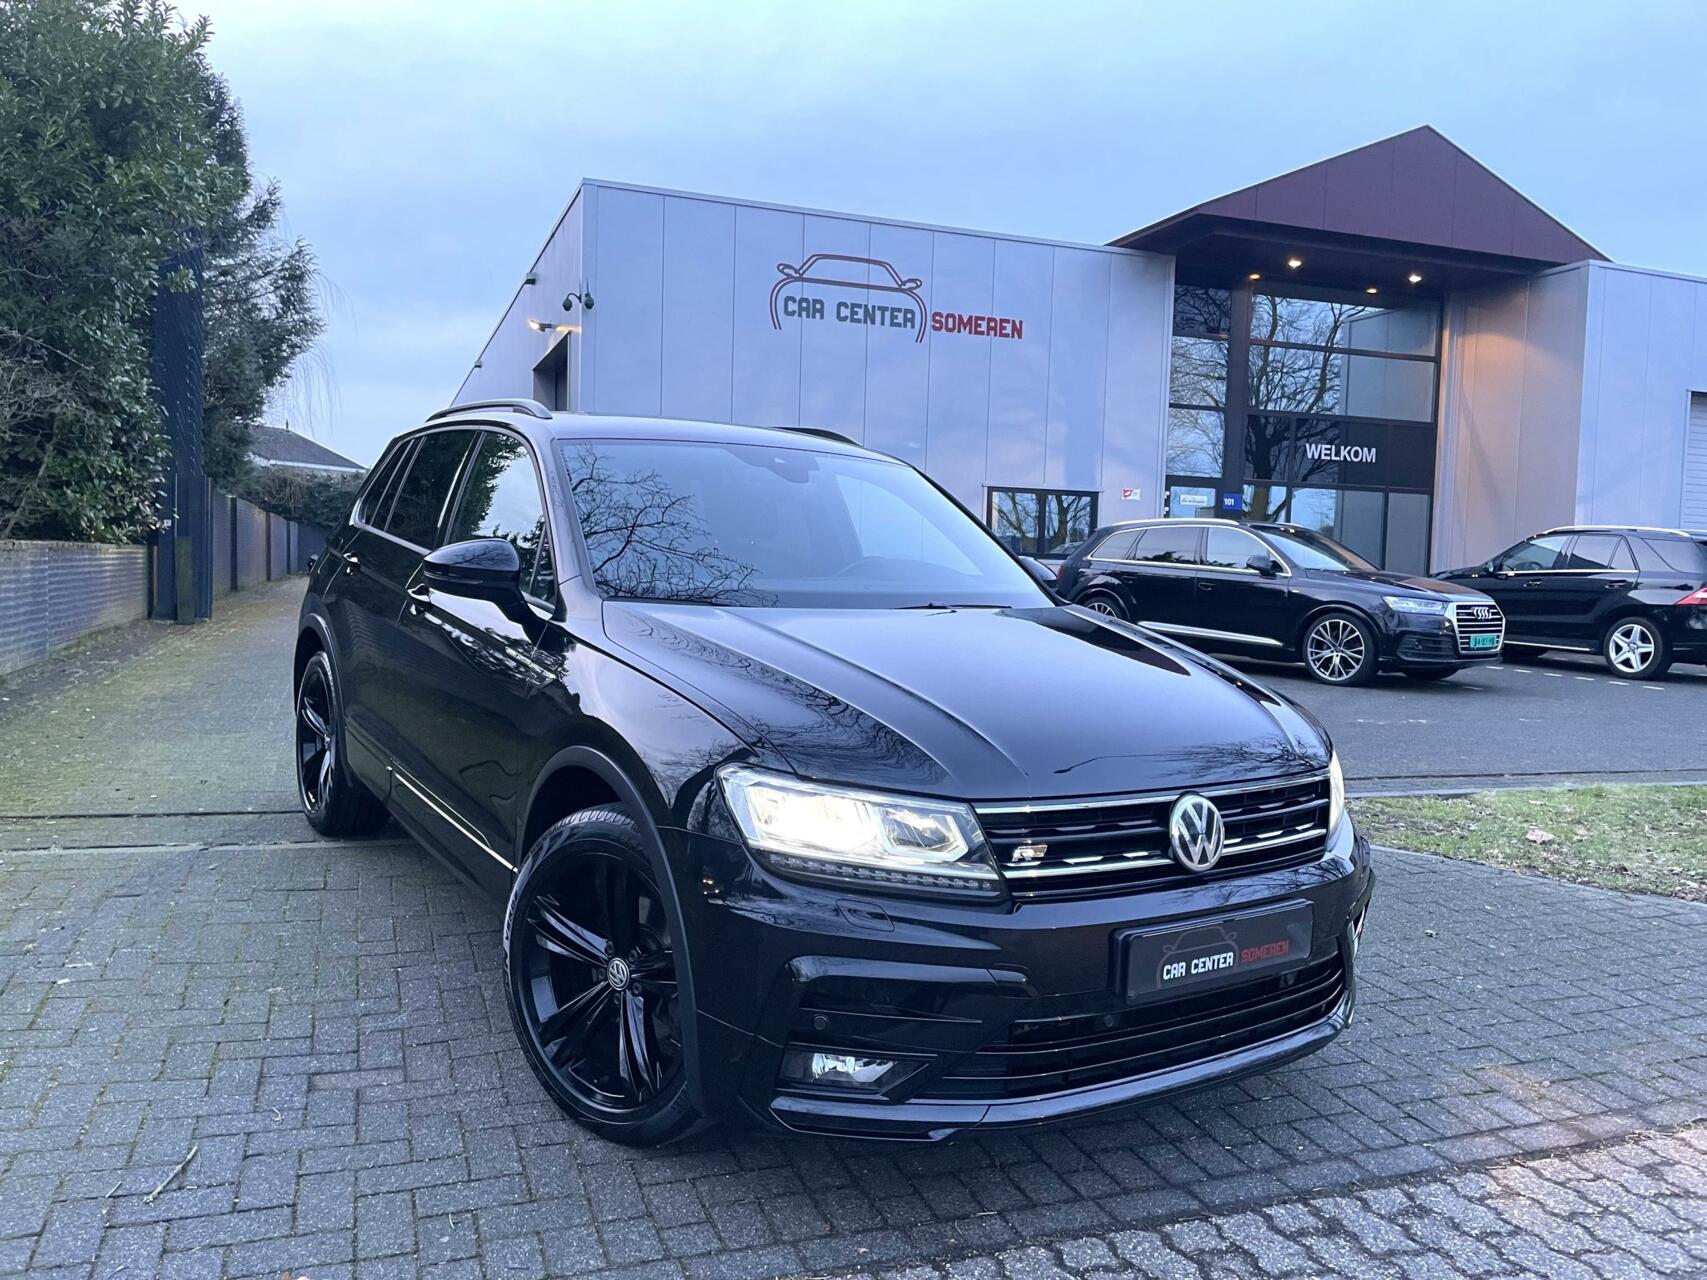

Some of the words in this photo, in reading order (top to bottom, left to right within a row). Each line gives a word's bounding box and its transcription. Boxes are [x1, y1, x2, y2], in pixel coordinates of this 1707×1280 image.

[783, 296, 825, 320] CAR
[836, 301, 916, 329] CENTER
[931, 312, 1024, 340] SOMEREN
[1305, 442, 1377, 463] WELKOM
[1223, 498, 1235, 506] 101
[1163, 961, 1187, 980] CAR
[1190, 951, 1234, 974] CENTER
[1241, 939, 1290, 963] SOMEREN
